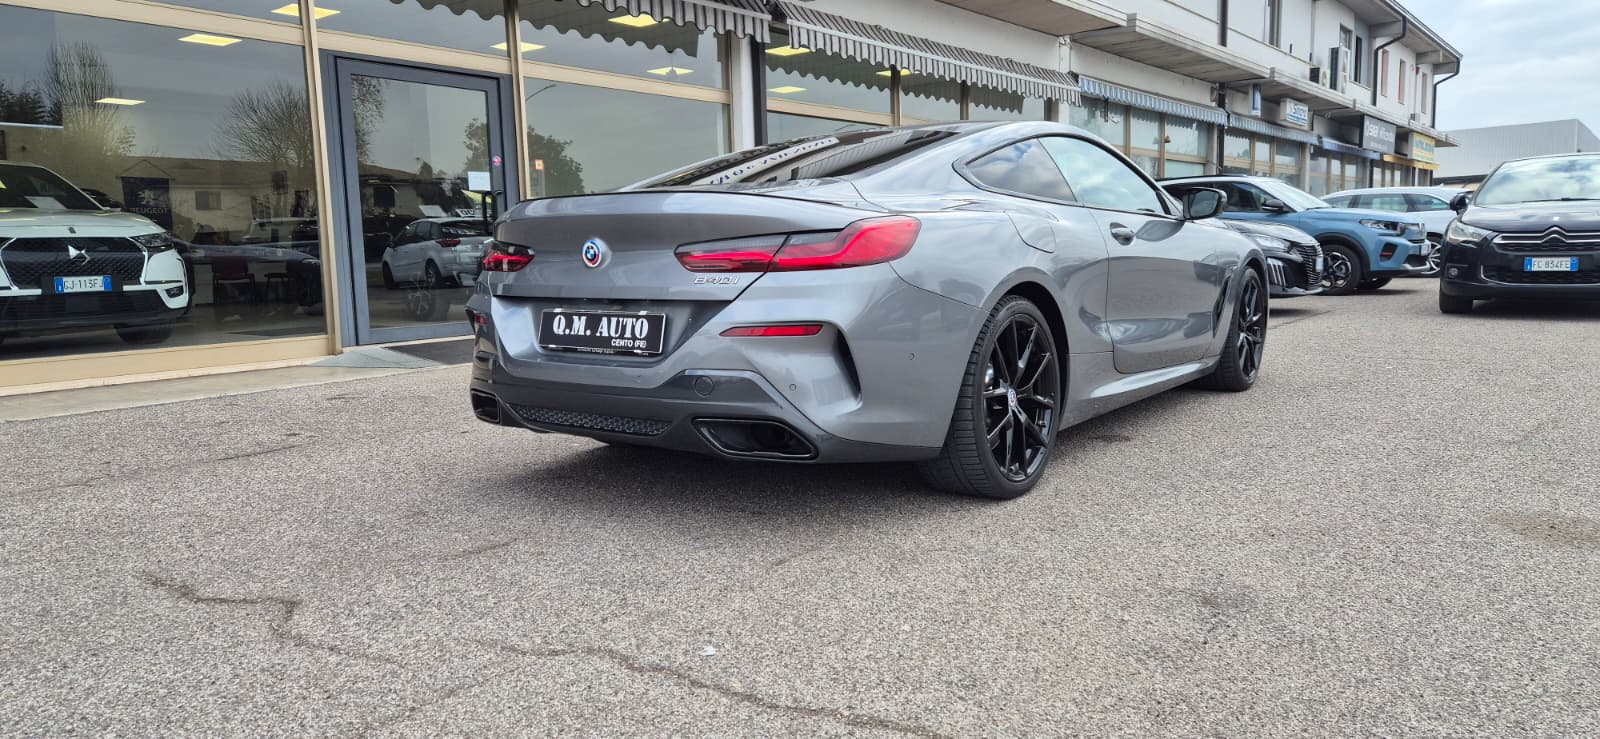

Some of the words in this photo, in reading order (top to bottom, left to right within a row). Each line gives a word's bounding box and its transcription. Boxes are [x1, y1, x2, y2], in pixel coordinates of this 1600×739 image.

[552, 314, 592, 337] Q.M.
[595, 316, 649, 339] AUTO
[611, 338, 634, 348] CENTO
[634, 339, 647, 349] (FE)
